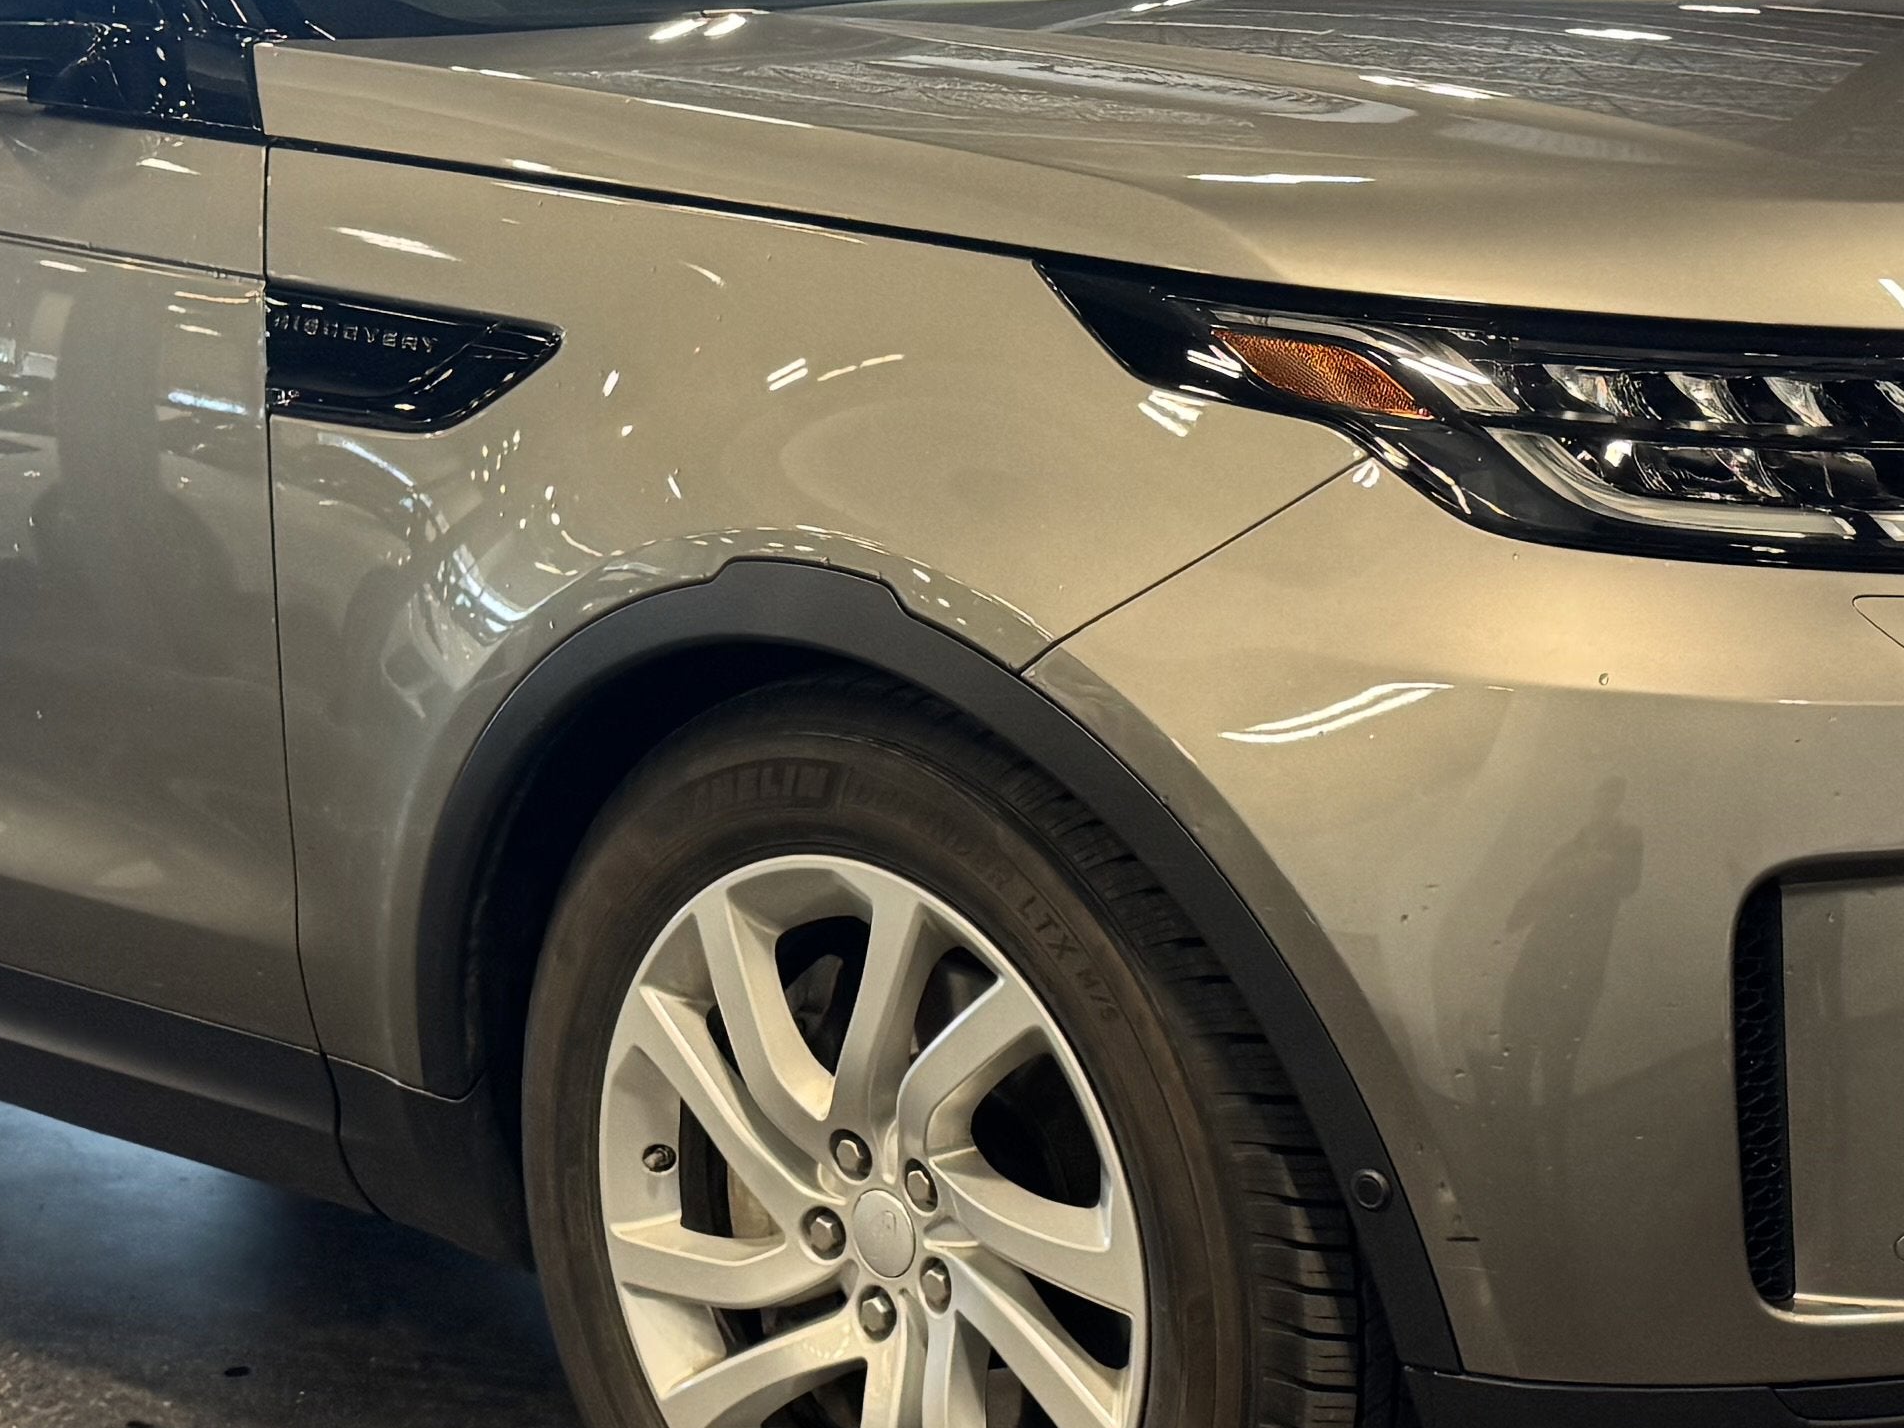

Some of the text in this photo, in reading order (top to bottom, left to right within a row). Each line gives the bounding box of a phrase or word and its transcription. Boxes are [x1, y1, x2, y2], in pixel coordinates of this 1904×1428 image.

[658, 763, 830, 828] CHELIN
[851, 771, 1015, 891] DNDER
[1016, 894, 1079, 961] LTX
